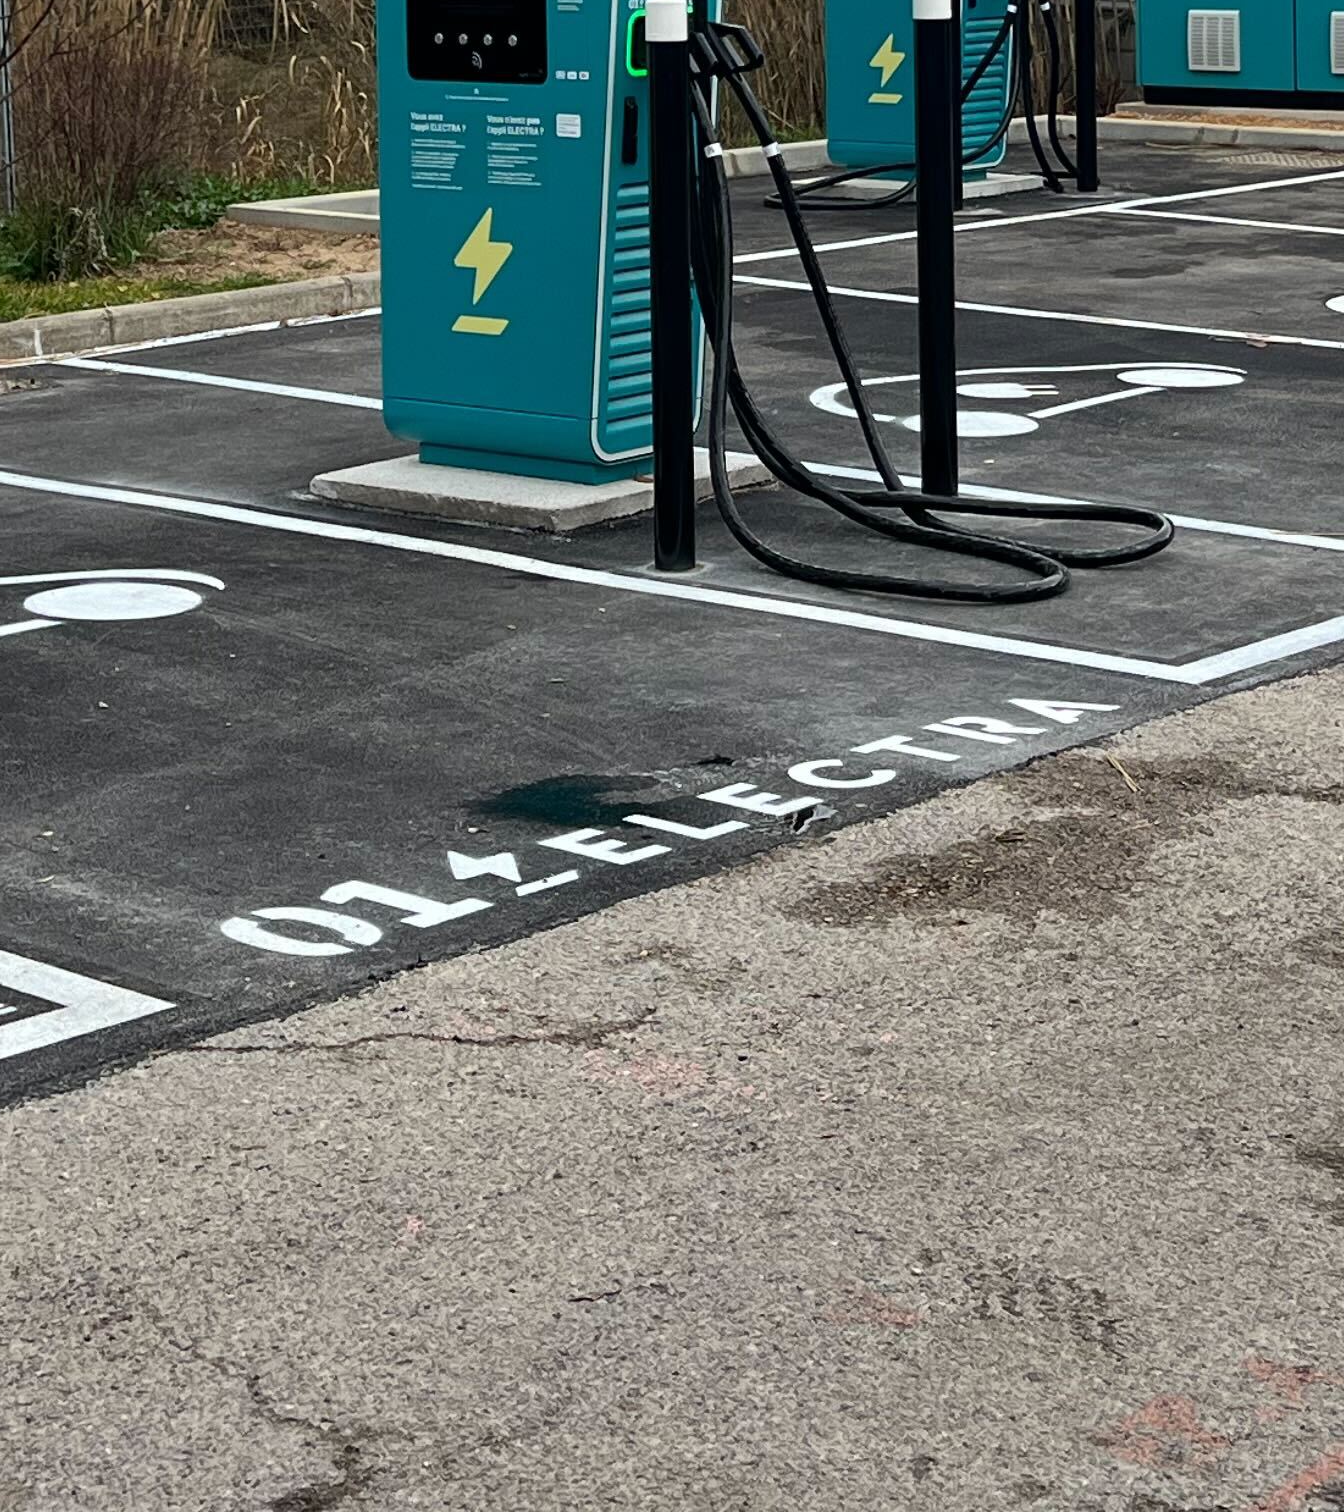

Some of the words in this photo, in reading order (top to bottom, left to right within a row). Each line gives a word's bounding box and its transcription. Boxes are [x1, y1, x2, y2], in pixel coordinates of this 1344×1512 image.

[430, 123, 461, 133] ELECTRA
[507, 126, 539, 136] ELECTRA
[220, 879, 494, 957] 01
[537, 696, 1121, 865] ELECTRA
